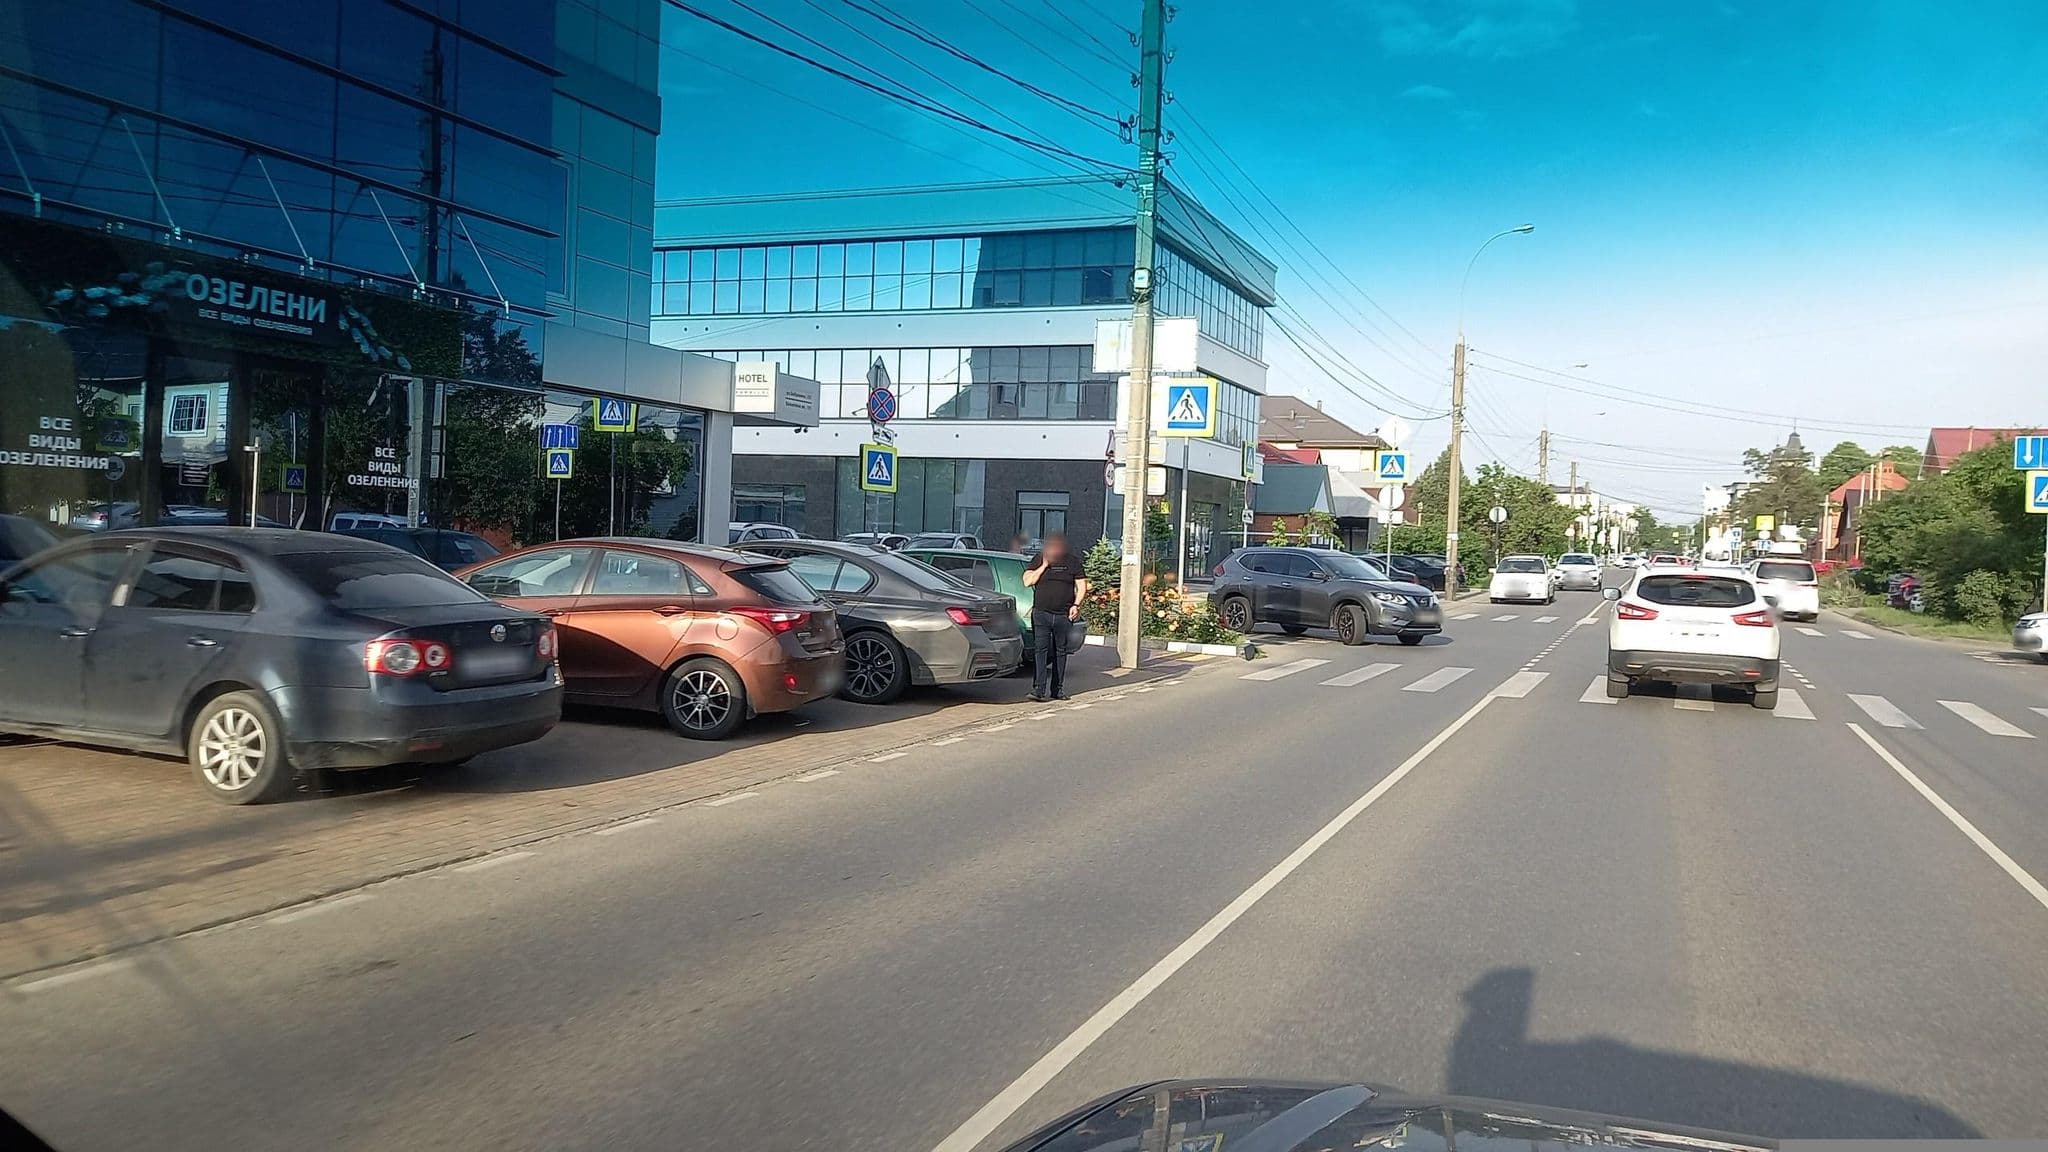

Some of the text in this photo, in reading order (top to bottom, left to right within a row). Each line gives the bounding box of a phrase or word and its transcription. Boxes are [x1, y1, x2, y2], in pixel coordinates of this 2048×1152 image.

[185, 273, 326, 323] ОЗЕЛЕНИ
[198, 308, 219, 320] ВСЕ
[220, 312, 251, 326] ВИДЫ
[738, 374, 769, 384] HOTEL
[39, 416, 73, 431] ВСЕ
[28, 434, 82, 452] ВИДЫ
[374, 446, 397, 459] ВСЕ
[0, 451, 110, 470] ОЗЕЛЕНЕНИЯ
[367, 461, 402, 476] ВИДЫ
[347, 474, 420, 489] ОЗЕЛЕНЕНИЯ
